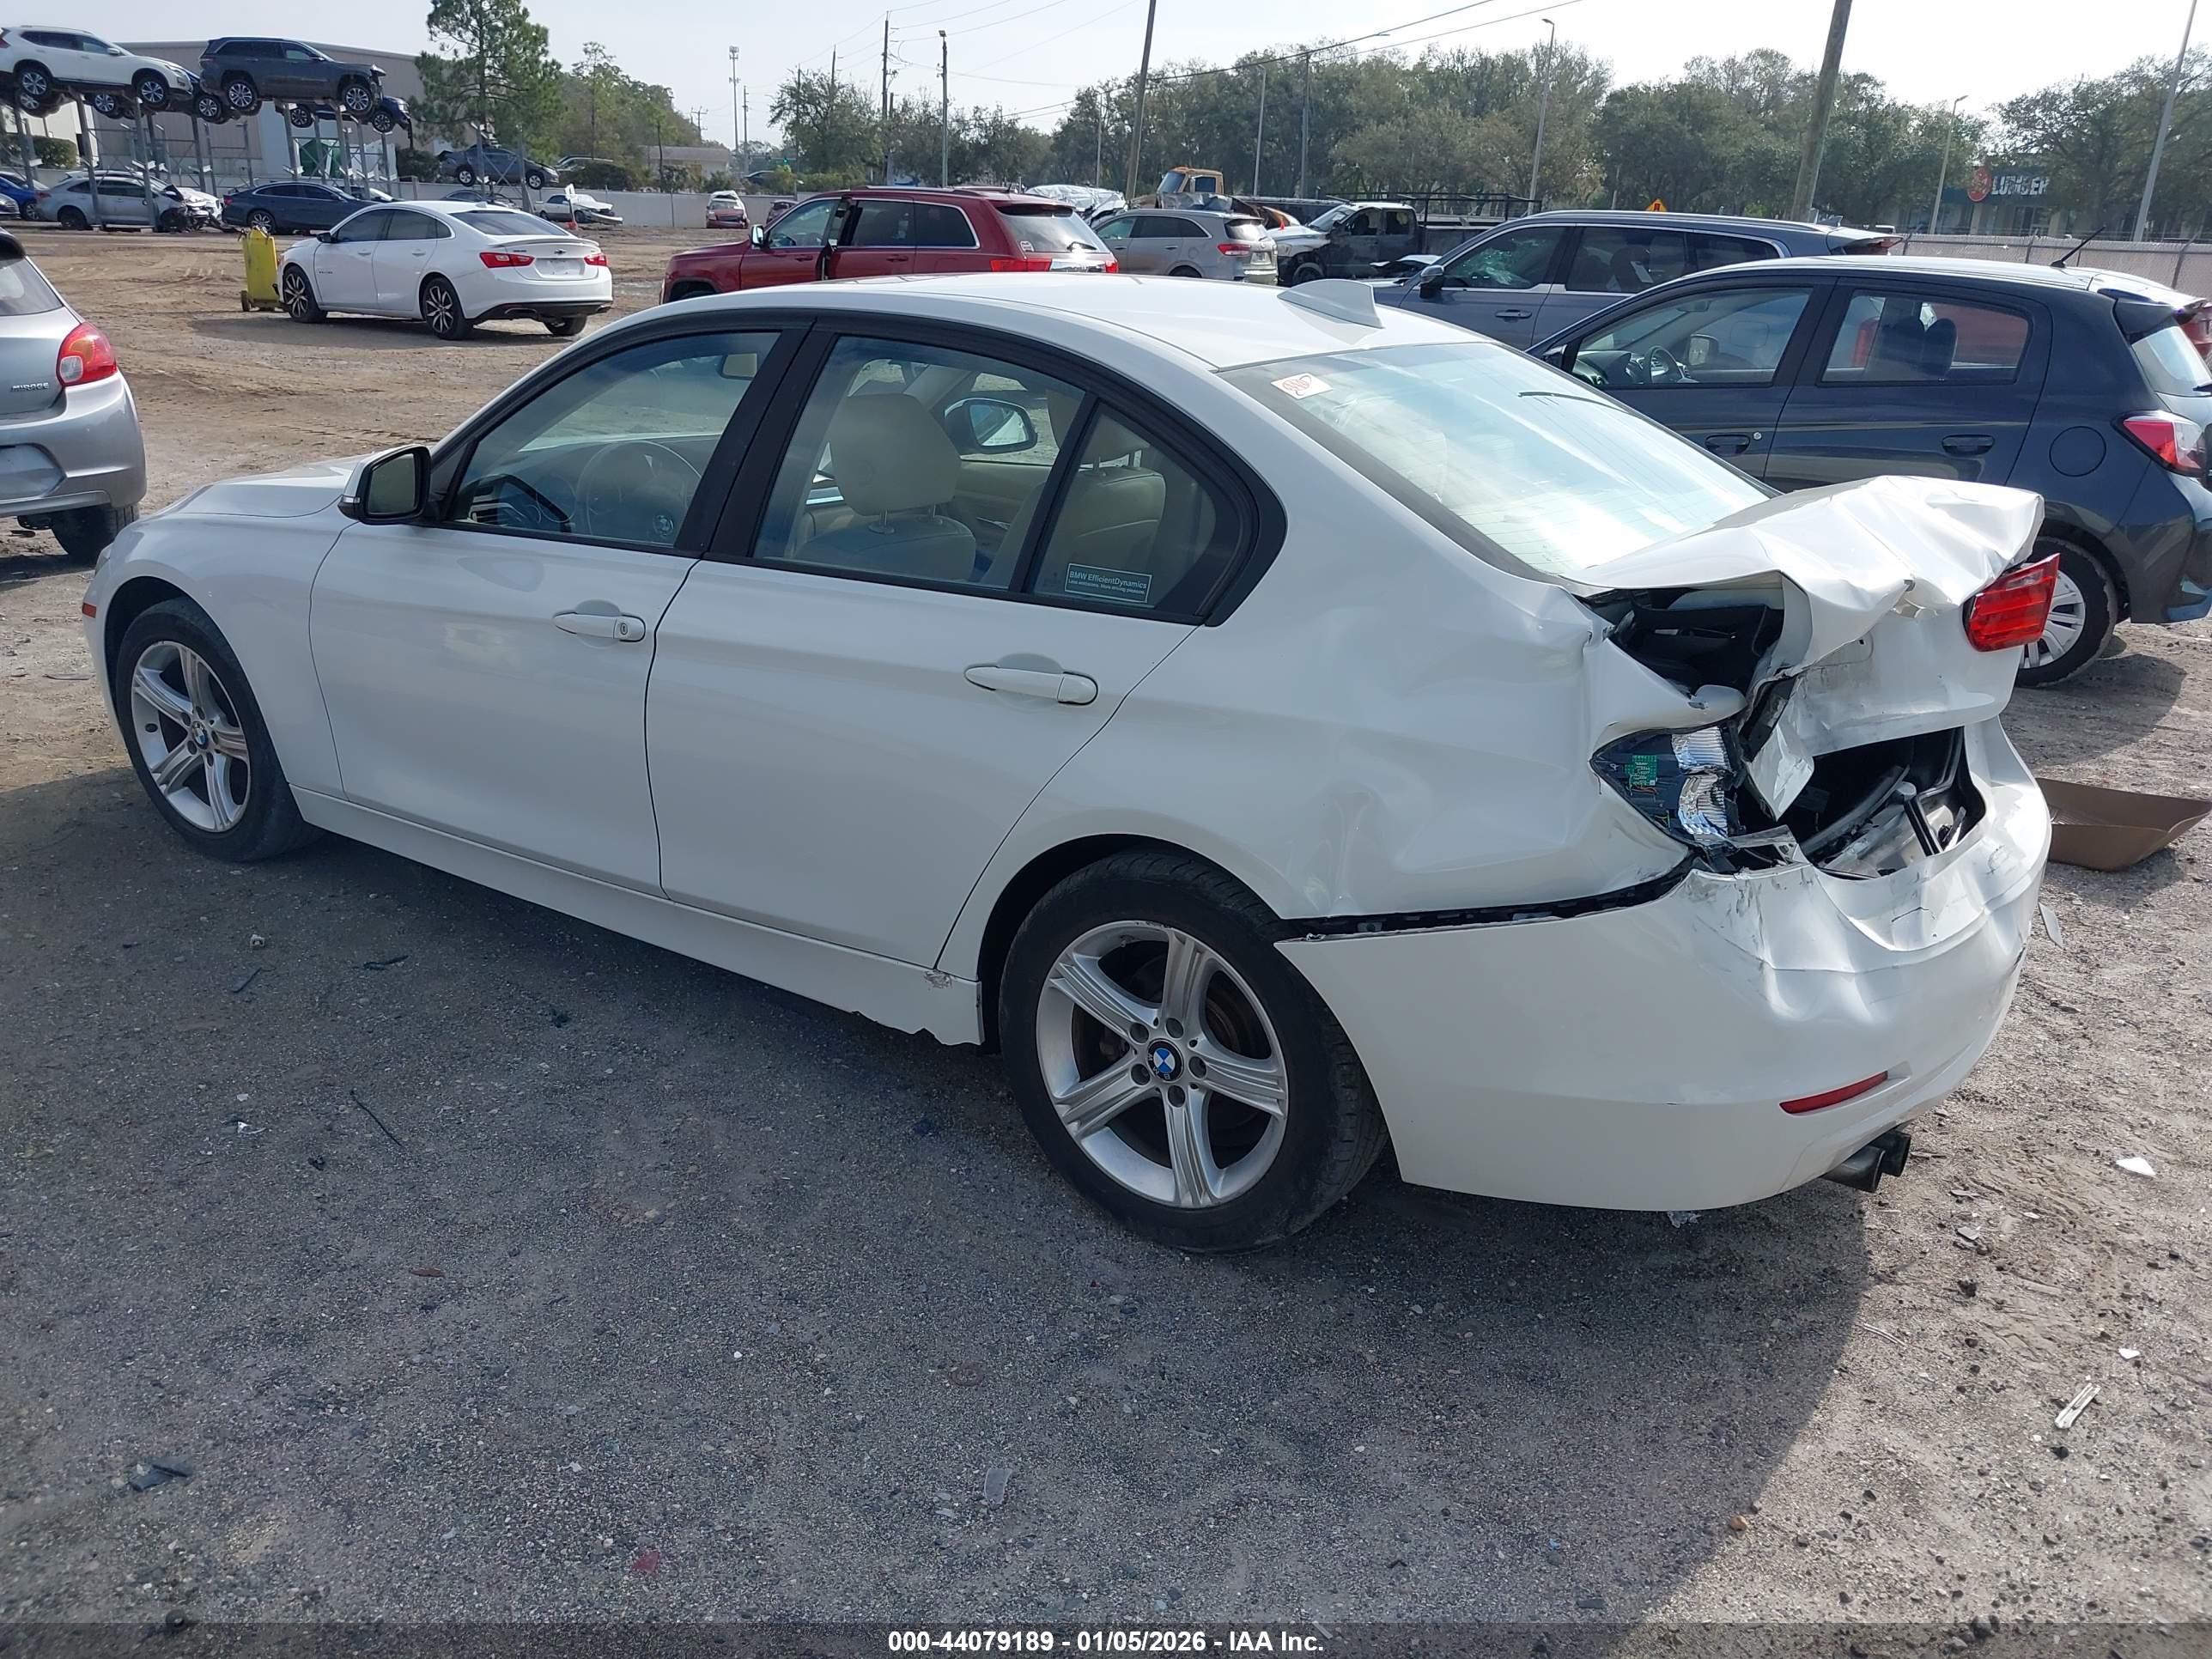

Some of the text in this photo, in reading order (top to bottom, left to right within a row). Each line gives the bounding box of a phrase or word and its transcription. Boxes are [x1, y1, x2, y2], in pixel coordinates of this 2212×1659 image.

[10, 382, 49, 392] MIRAGE
[1069, 570, 1147, 588] BMW EfficientDynamics
